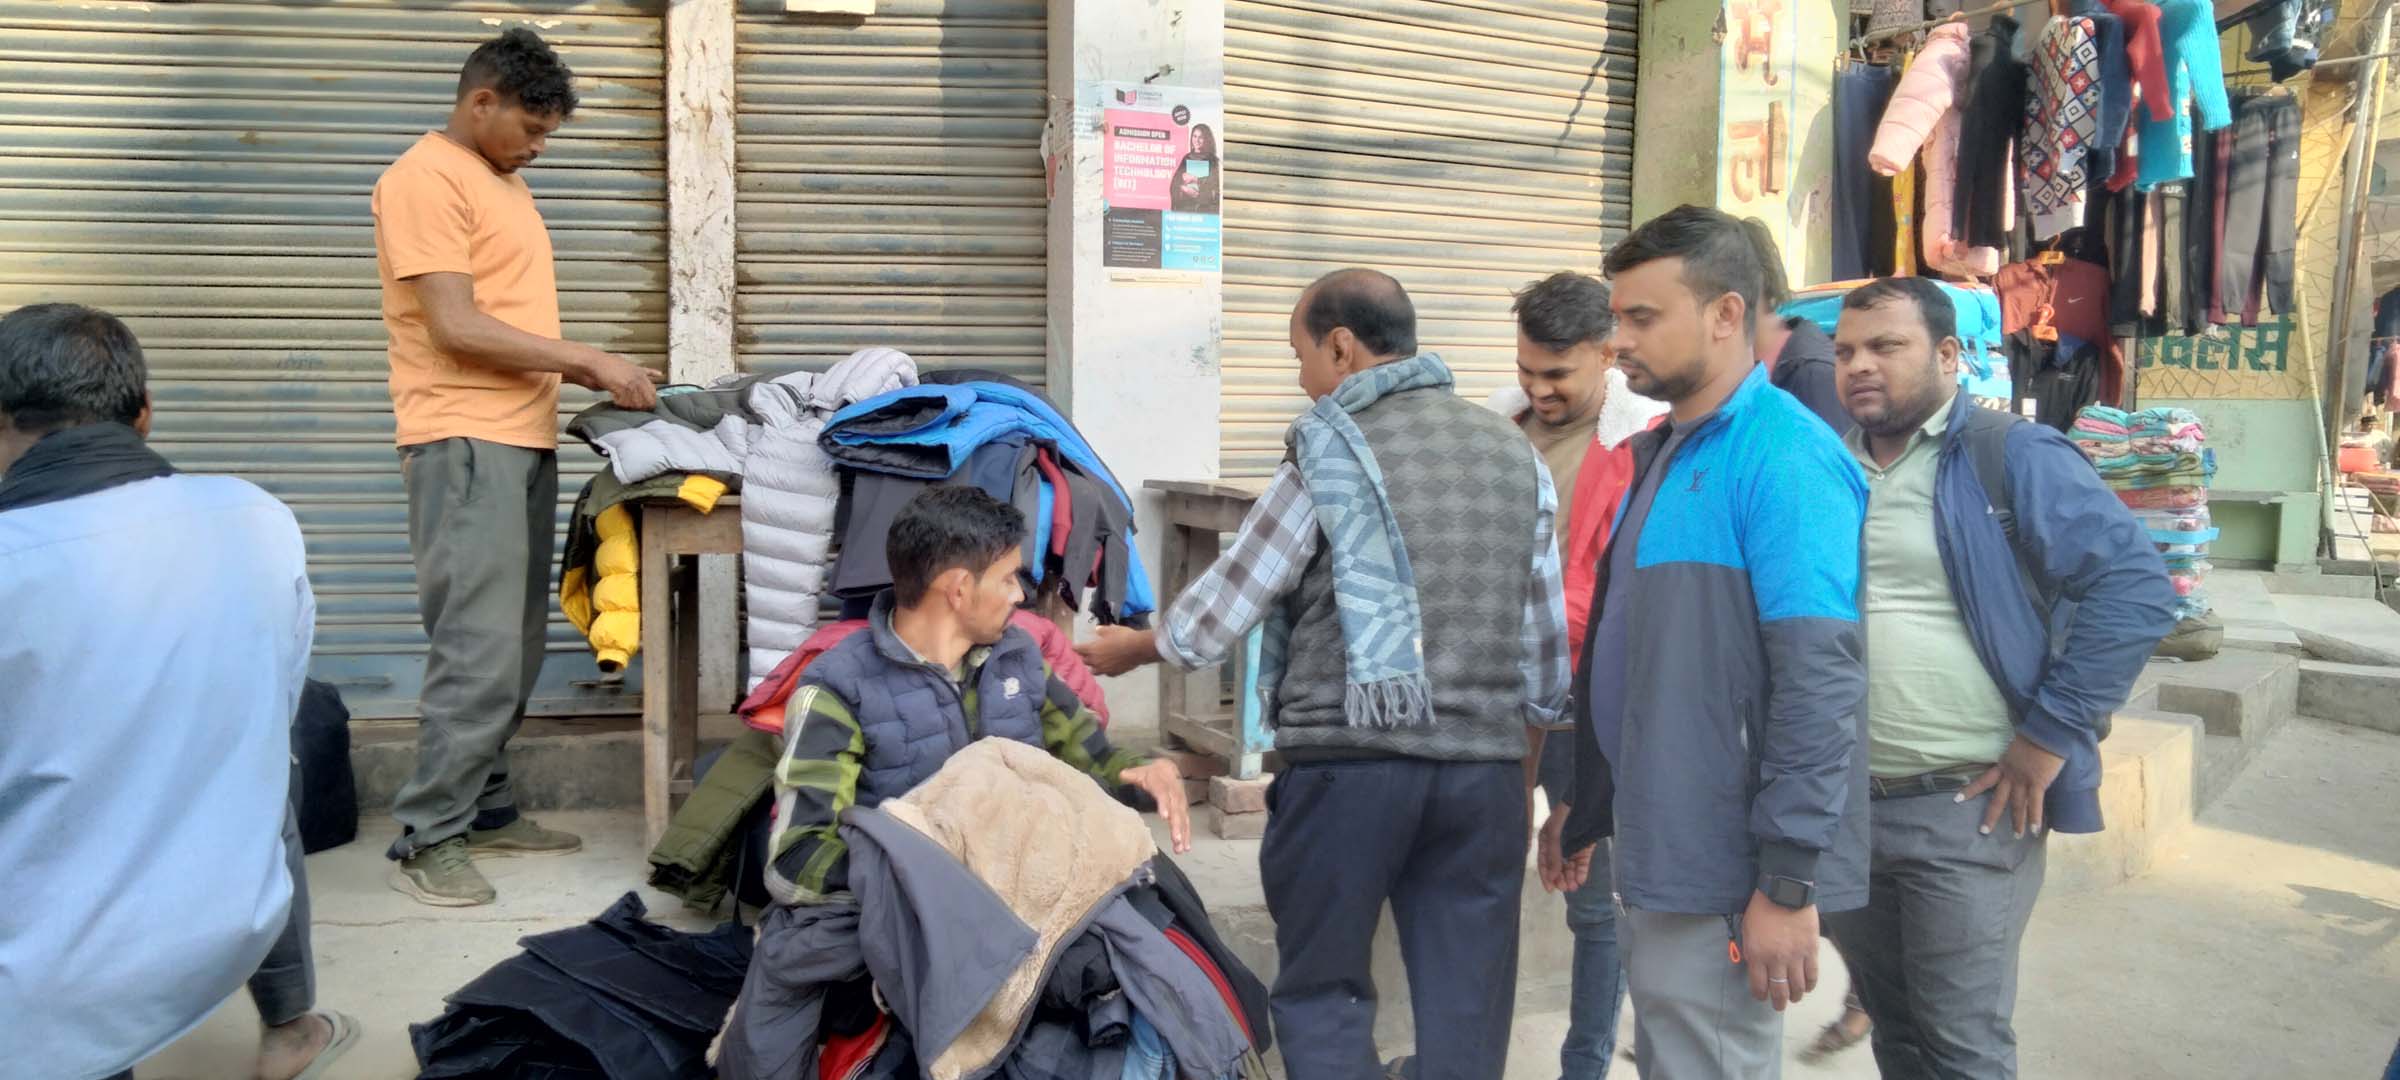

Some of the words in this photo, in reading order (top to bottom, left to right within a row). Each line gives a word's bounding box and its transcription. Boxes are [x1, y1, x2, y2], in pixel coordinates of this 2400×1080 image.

[1119, 128, 1151, 138] ADMISSION
[1151, 130, 1167, 139] OPEN
[1114, 140, 1162, 153] BACHELOR
[1163, 143, 1177, 154] OF
[1114, 152, 1176, 168] INFORMATION
[1114, 166, 1172, 179] TECHNOLOGY
